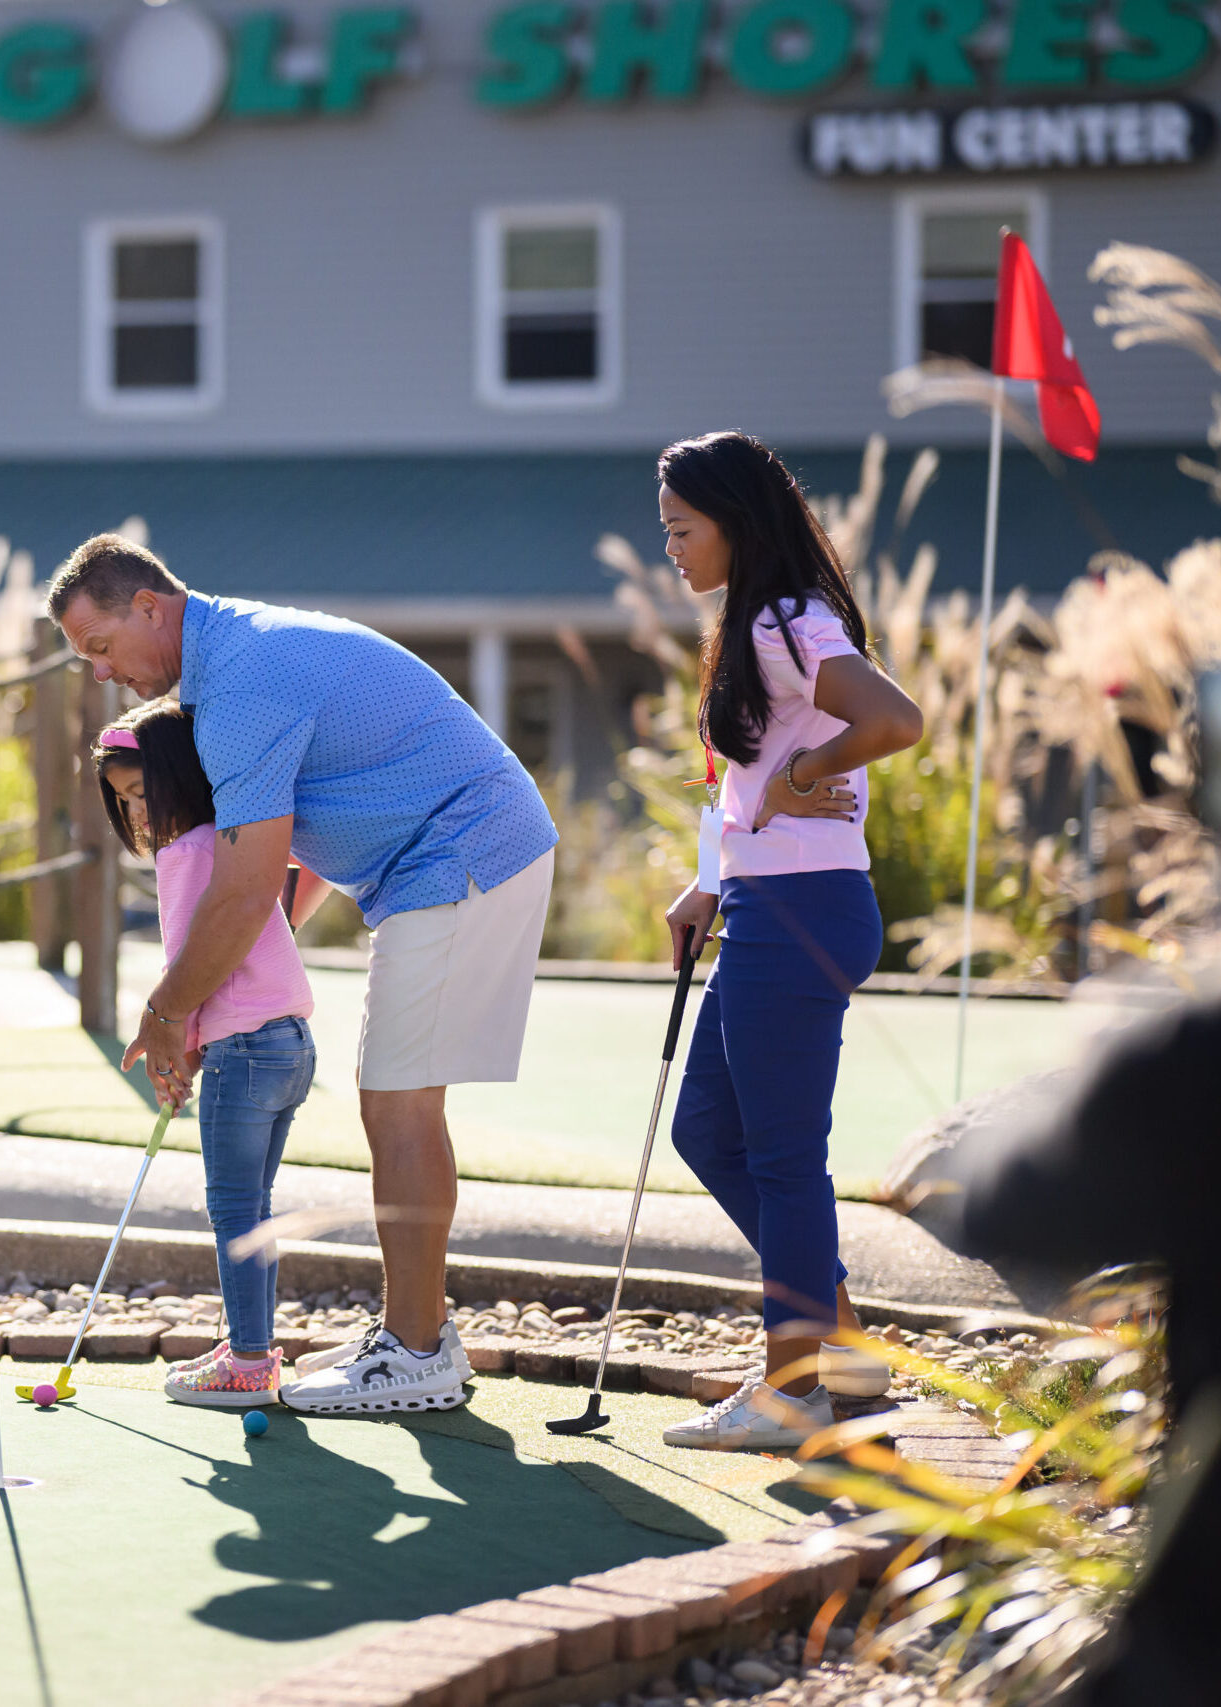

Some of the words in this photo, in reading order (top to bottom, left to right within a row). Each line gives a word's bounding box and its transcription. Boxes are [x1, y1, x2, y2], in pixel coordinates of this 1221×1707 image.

[474, 0, 1214, 109] SHORES
[811, 111, 942, 174] FUN
[955, 102, 1192, 170] CENTER
